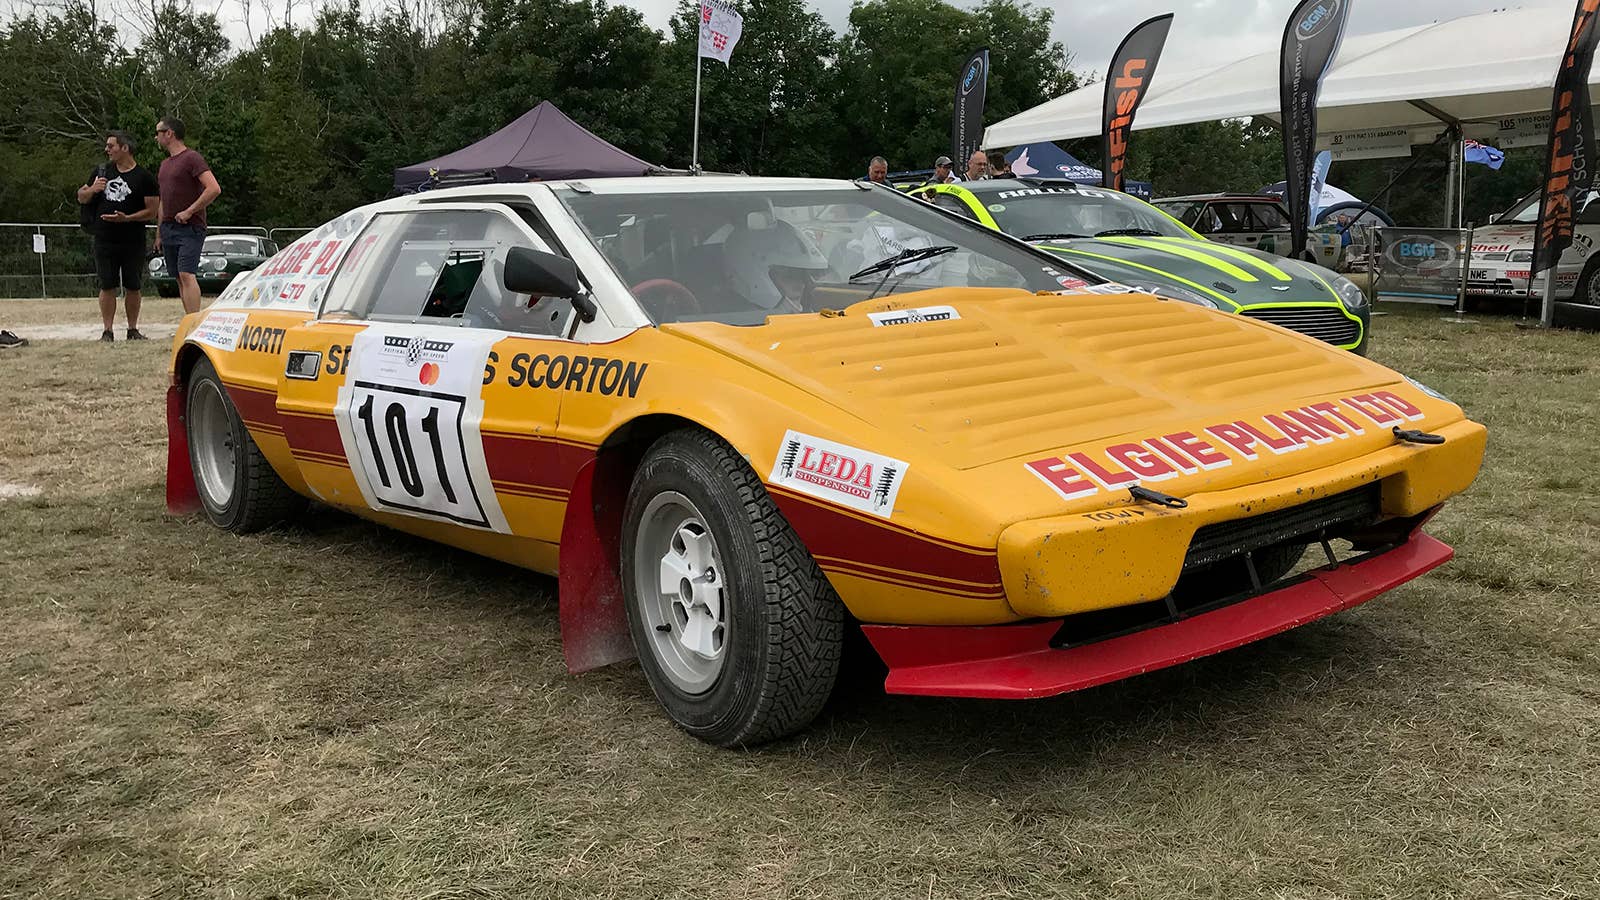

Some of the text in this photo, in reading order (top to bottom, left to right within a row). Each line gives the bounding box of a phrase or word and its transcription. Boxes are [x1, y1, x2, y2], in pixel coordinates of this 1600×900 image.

[1300, 4, 1327, 31] BGM
[1499, 119, 1516, 128] 105
[261, 240, 321, 276] ELGIE
[1400, 243, 1436, 257] BGM
[1470, 270, 1488, 279] NME
[279, 282, 306, 300] LTD
[508, 353, 648, 398] SCORTON
[358, 394, 458, 504] 101
[1024, 390, 1426, 501] ELGIE PLANT LTD
[797, 445, 874, 489] LEDA
[795, 470, 872, 499] SUSPENSION
[1082, 508, 1132, 522] TOW
